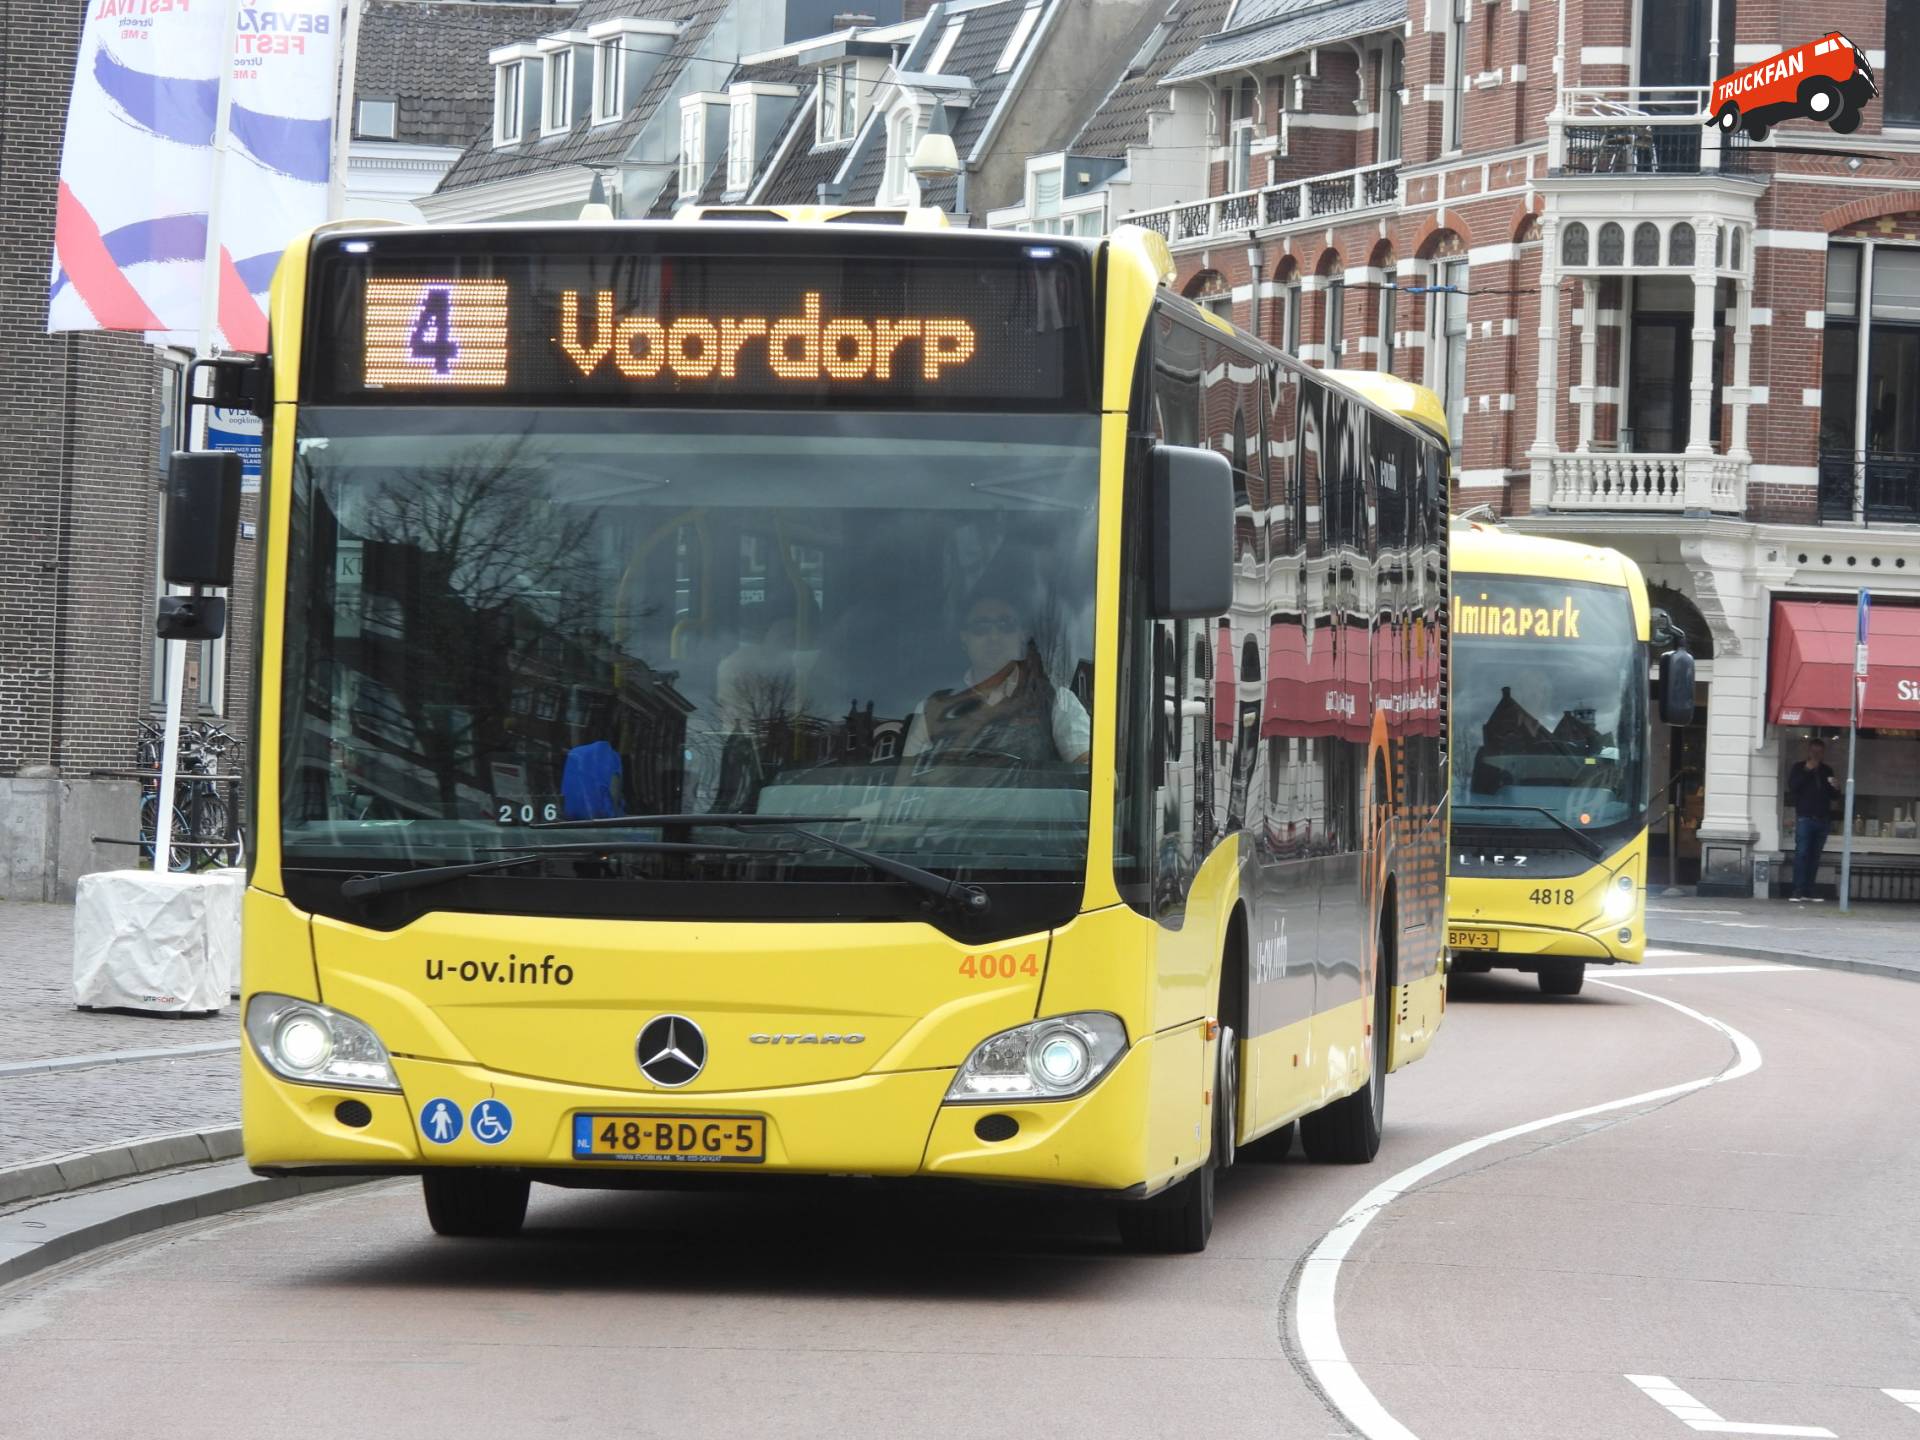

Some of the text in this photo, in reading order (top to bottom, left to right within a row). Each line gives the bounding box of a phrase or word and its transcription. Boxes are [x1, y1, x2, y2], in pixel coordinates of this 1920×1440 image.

[410, 287, 976, 380] 4 Voordorp
[1898, 680, 1920, 700] Si
[499, 804, 557, 823] 206
[1460, 854, 1528, 867] LIEZ
[1529, 888, 1575, 905] 4818
[1450, 932, 1489, 945] BPV-3
[426, 953, 574, 986] u-ov.info
[959, 953, 1039, 979] 4004
[750, 1033, 866, 1045] CITARO
[577, 1121, 754, 1152] NL 48-BDG-5
